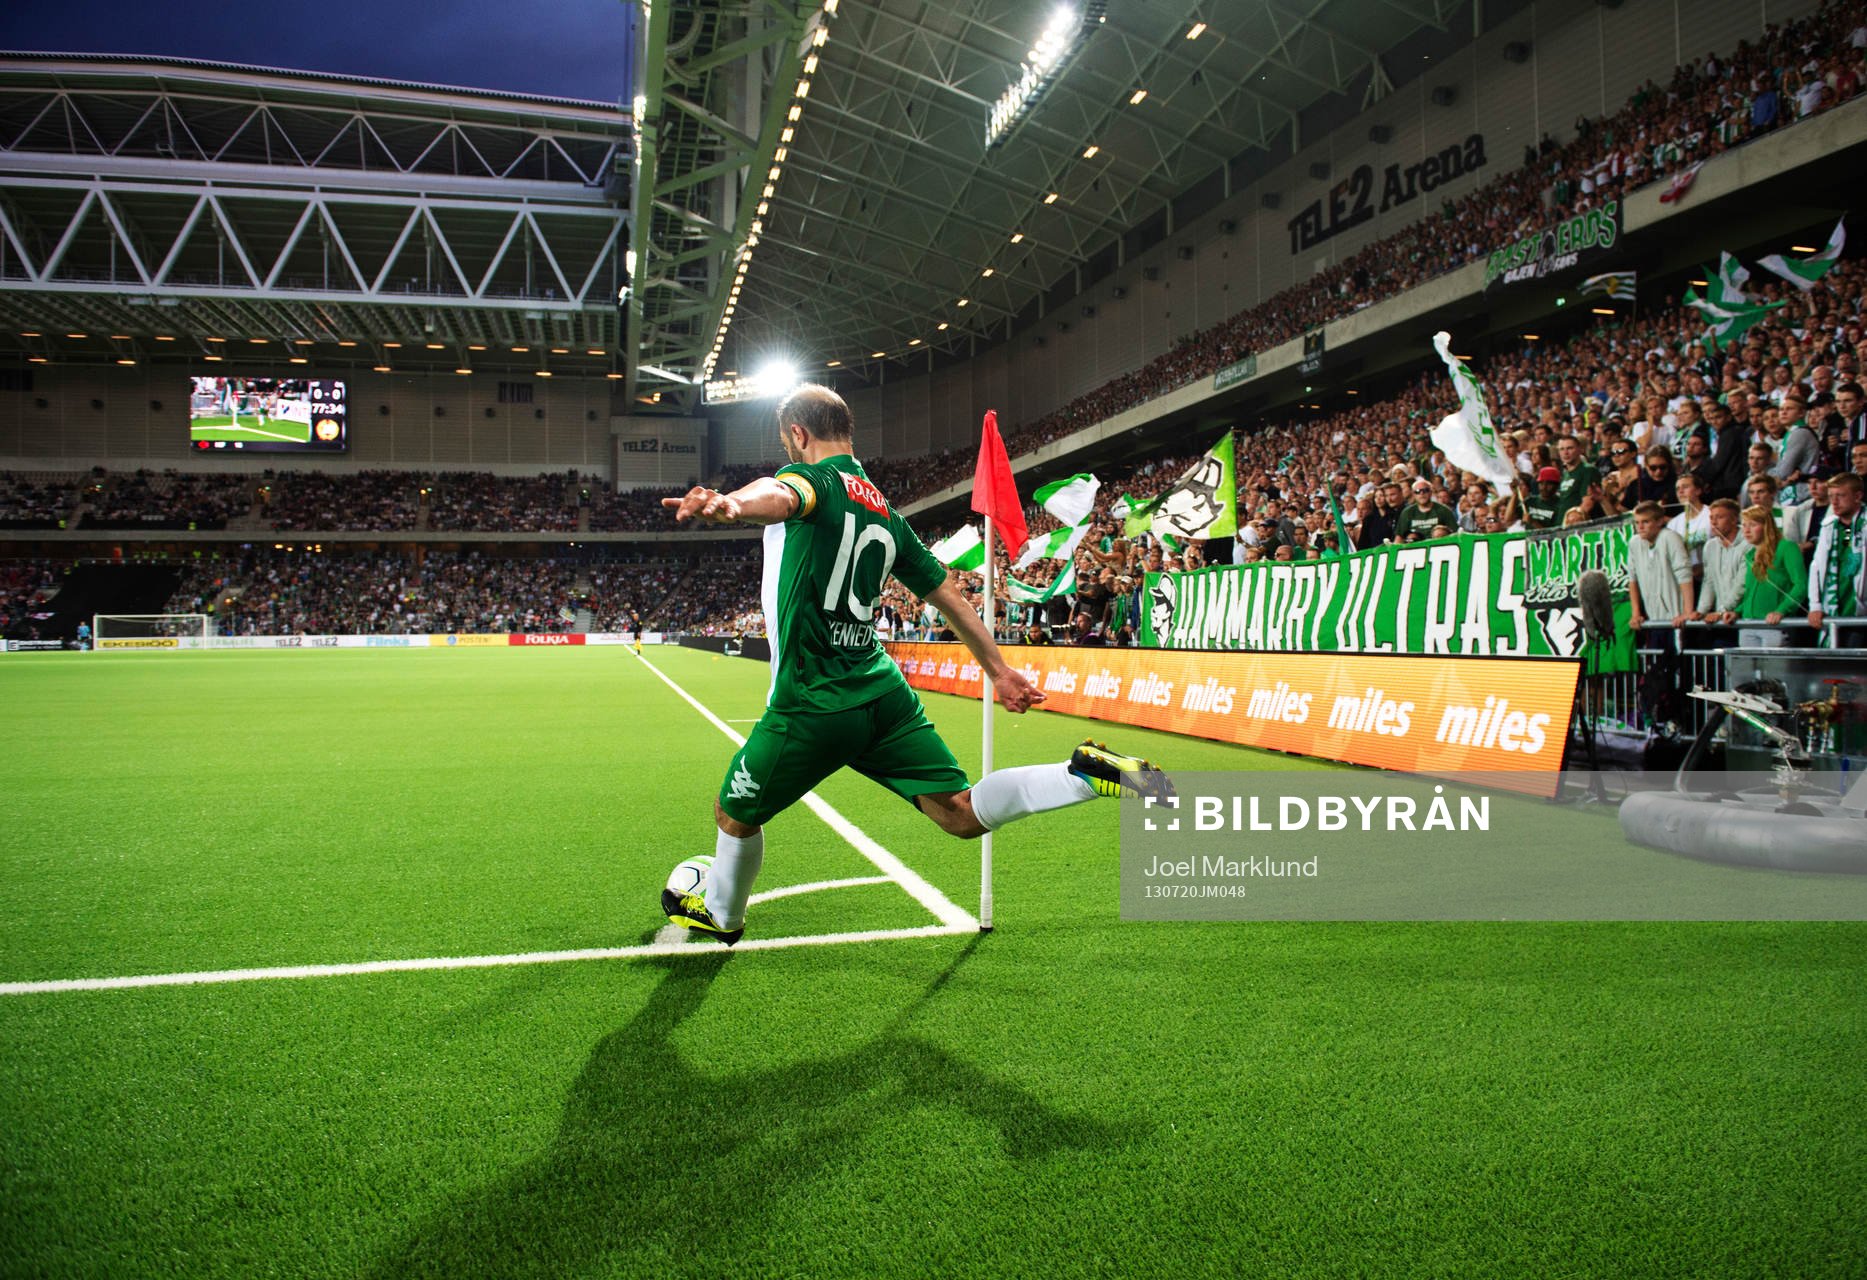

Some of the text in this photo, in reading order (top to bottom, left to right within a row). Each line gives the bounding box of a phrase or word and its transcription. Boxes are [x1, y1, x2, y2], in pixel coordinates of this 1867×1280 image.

[1287, 133, 1488, 256] TELE2 Arena
[312, 403, 343, 414] 77:34
[623, 438, 697, 454] TELE2 Arena
[823, 511, 897, 621] 10
[1528, 522, 1634, 589] MARTIN
[1335, 539, 1529, 656] ULTRAS
[275, 637, 302, 647] TELE2
[312, 637, 338, 647] TELE2
[1044, 665, 1078, 694] miles
[1083, 668, 1121, 699] miles
[1127, 672, 1173, 707] miles
[1181, 677, 1236, 714] miles
[1246, 681, 1312, 724] miles
[1327, 687, 1415, 737] miles
[1435, 695, 1551, 754] miles
